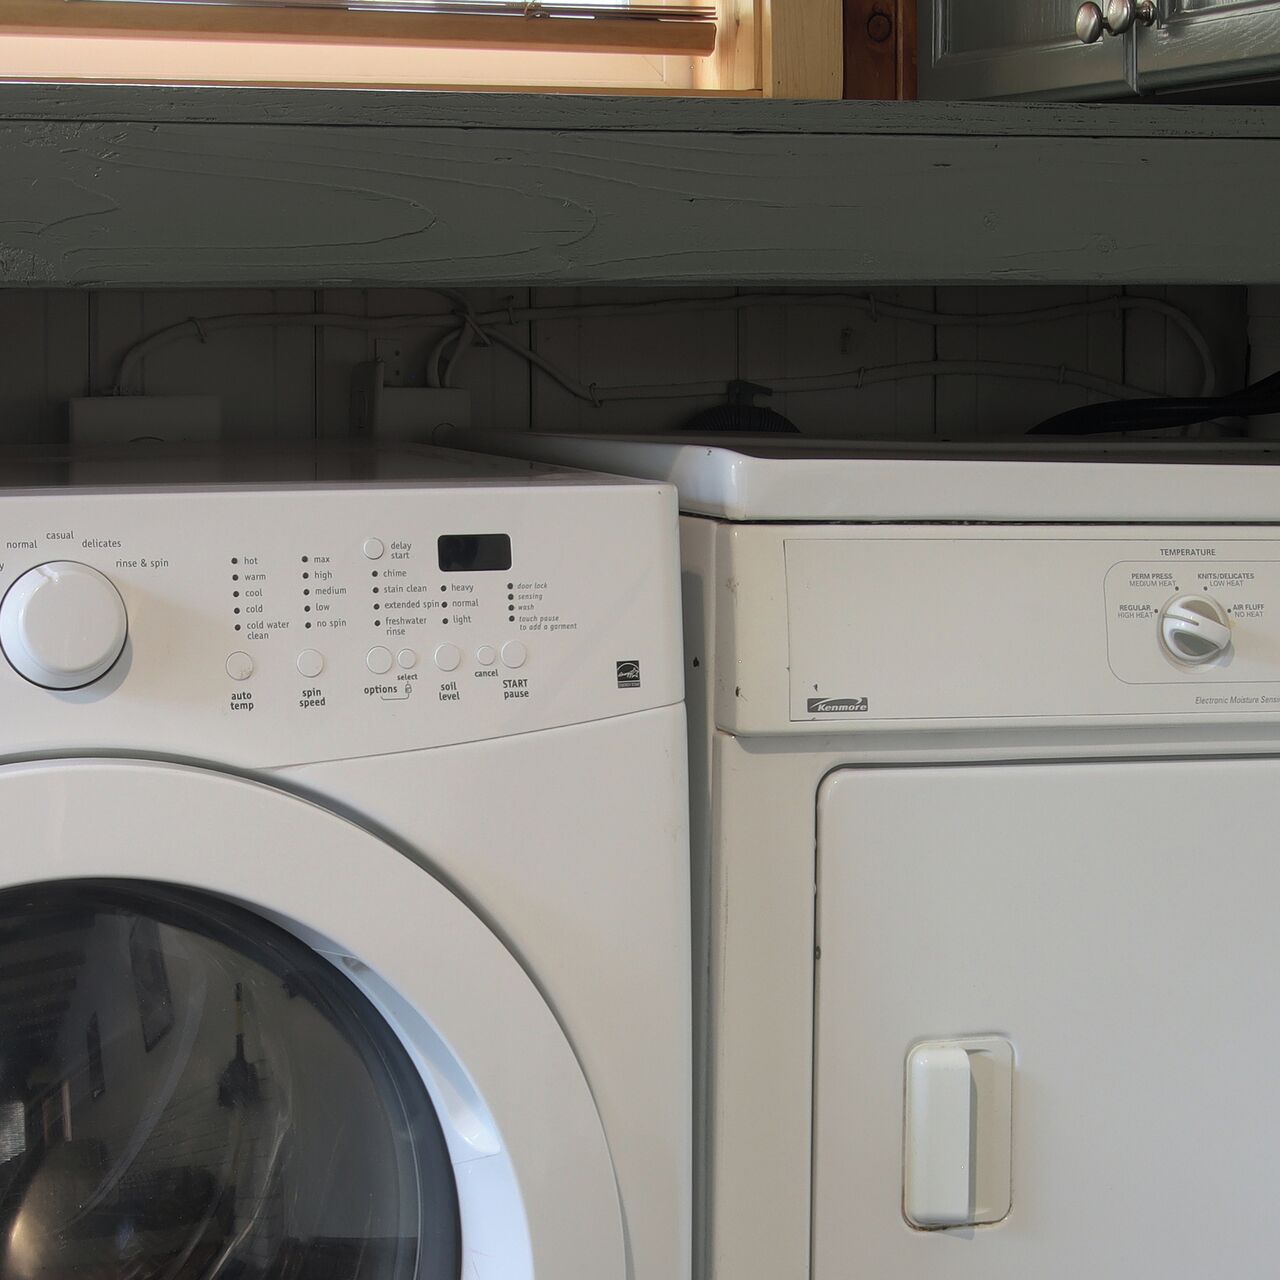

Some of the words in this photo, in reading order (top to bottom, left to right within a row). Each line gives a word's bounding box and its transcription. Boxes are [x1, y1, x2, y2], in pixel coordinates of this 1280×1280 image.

[46, 531, 74, 540] casual
[6, 540, 37, 549] normal
[82, 539, 121, 548] delicates
[391, 541, 412, 551] delay
[391, 552, 409, 560] start
[116, 559, 138, 568] rinse
[140, 559, 147, 568] &
[150, 559, 169, 569] spin
[244, 557, 258, 565] hot
[314, 572, 332, 580] high
[383, 569, 407, 577] chime
[315, 587, 346, 595] medium
[384, 585, 403, 593] stain
[406, 584, 427, 592] clean
[451, 583, 474, 592] heavy
[245, 589, 262, 597] cool
[316, 603, 330, 611] low
[385, 600, 420, 609] extended
[423, 600, 439, 609] spin
[452, 599, 478, 607] normal
[246, 604, 263, 613] cold
[330, 619, 346, 628] spin
[386, 616, 427, 625] freshwater
[453, 615, 472, 624] light
[247, 621, 264, 629] cold
[267, 621, 289, 629] water
[550, 623, 577, 631] garment
[247, 631, 269, 640] clean
[474, 669, 498, 677] cancel
[441, 682, 456, 691] soil
[503, 679, 528, 688] START
[302, 688, 321, 698] spin
[364, 684, 398, 696] options
[231, 692, 252, 700] auto
[439, 692, 460, 701] level
[504, 690, 529, 700] pause
[299, 698, 325, 708] speed
[1195, 696, 1228, 704] Electronic
[1230, 696, 1259, 704] Moisture
[231, 702, 254, 711] temp
